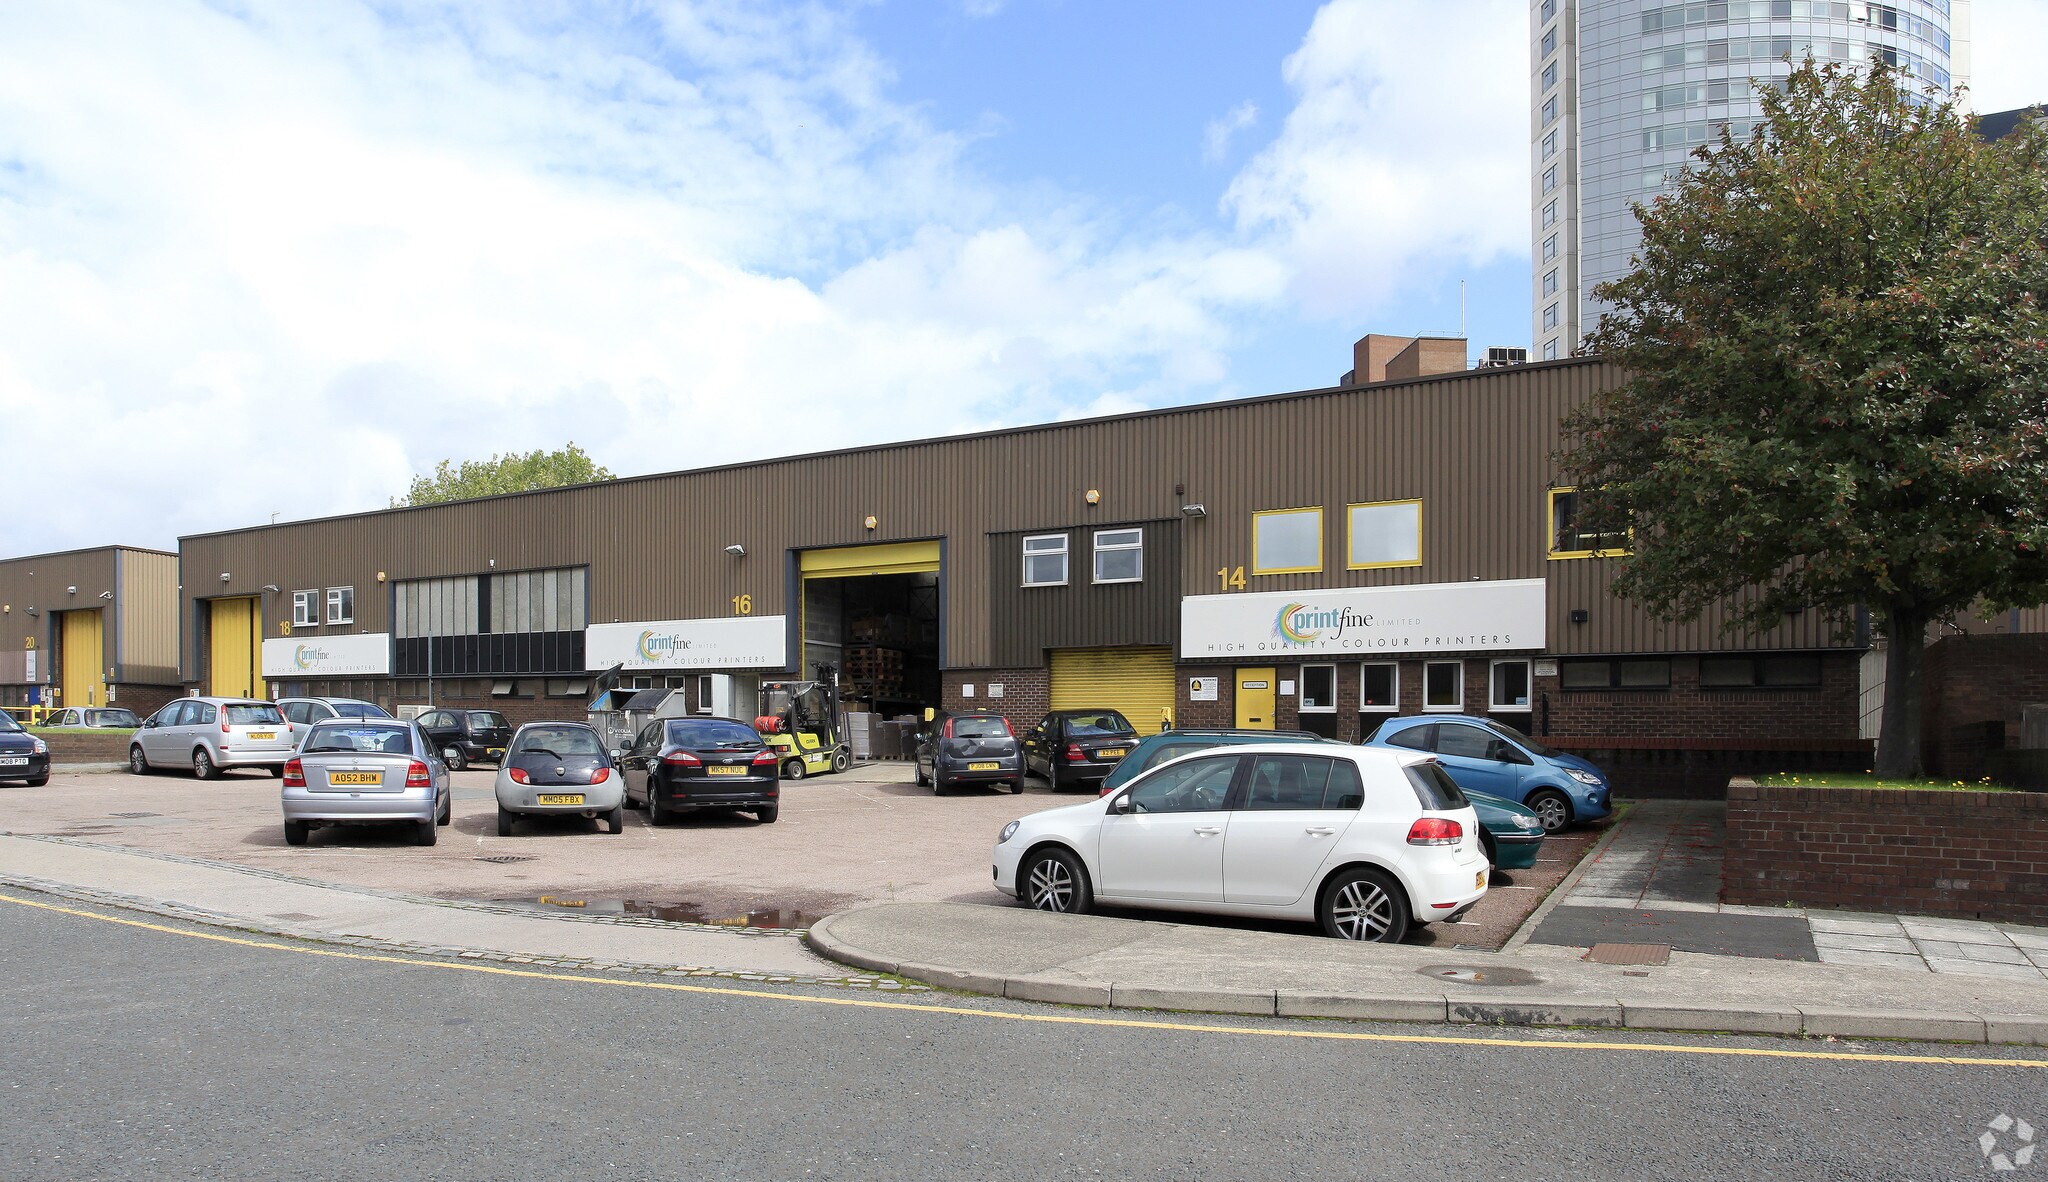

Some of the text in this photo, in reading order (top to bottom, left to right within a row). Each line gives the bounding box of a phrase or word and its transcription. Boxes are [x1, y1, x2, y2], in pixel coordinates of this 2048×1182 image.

[1217, 566, 1247, 591] 14
[732, 594, 752, 615] 16
[279, 620, 291, 636] 18
[1294, 606, 1421, 640] printfine LIMITED
[25, 636, 35, 649] 20
[647, 633, 692, 659] printfine
[1208, 634, 1512, 652] HIGH QUALITY COLOUR PRINTERS
[627, 658, 667, 666] QUALITY
[718, 655, 766, 663] PRINTERS
